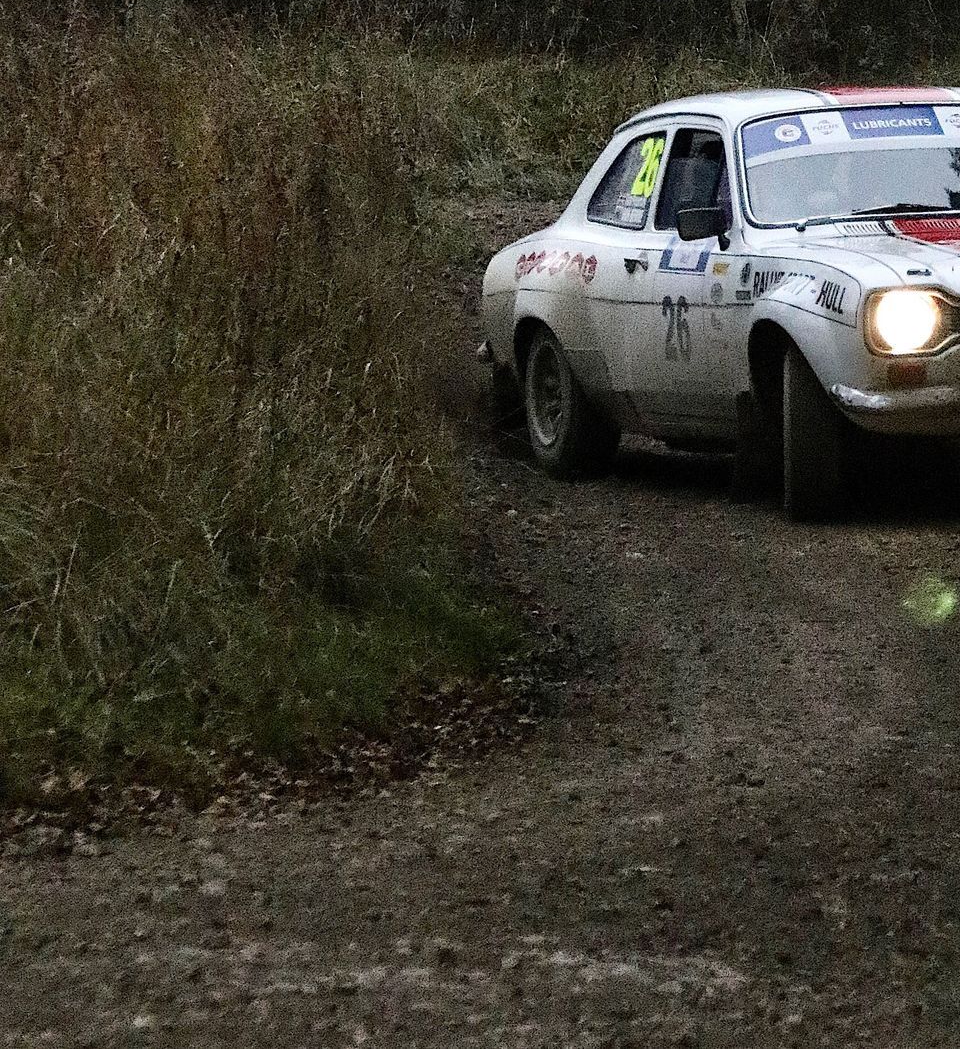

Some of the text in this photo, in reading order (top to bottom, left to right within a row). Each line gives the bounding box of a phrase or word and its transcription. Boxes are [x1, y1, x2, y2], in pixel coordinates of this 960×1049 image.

[852, 118, 932, 130] LUBRICANTS
[631, 137, 664, 198] 26
[815, 279, 846, 314] HULL
[662, 296, 691, 360] 26
